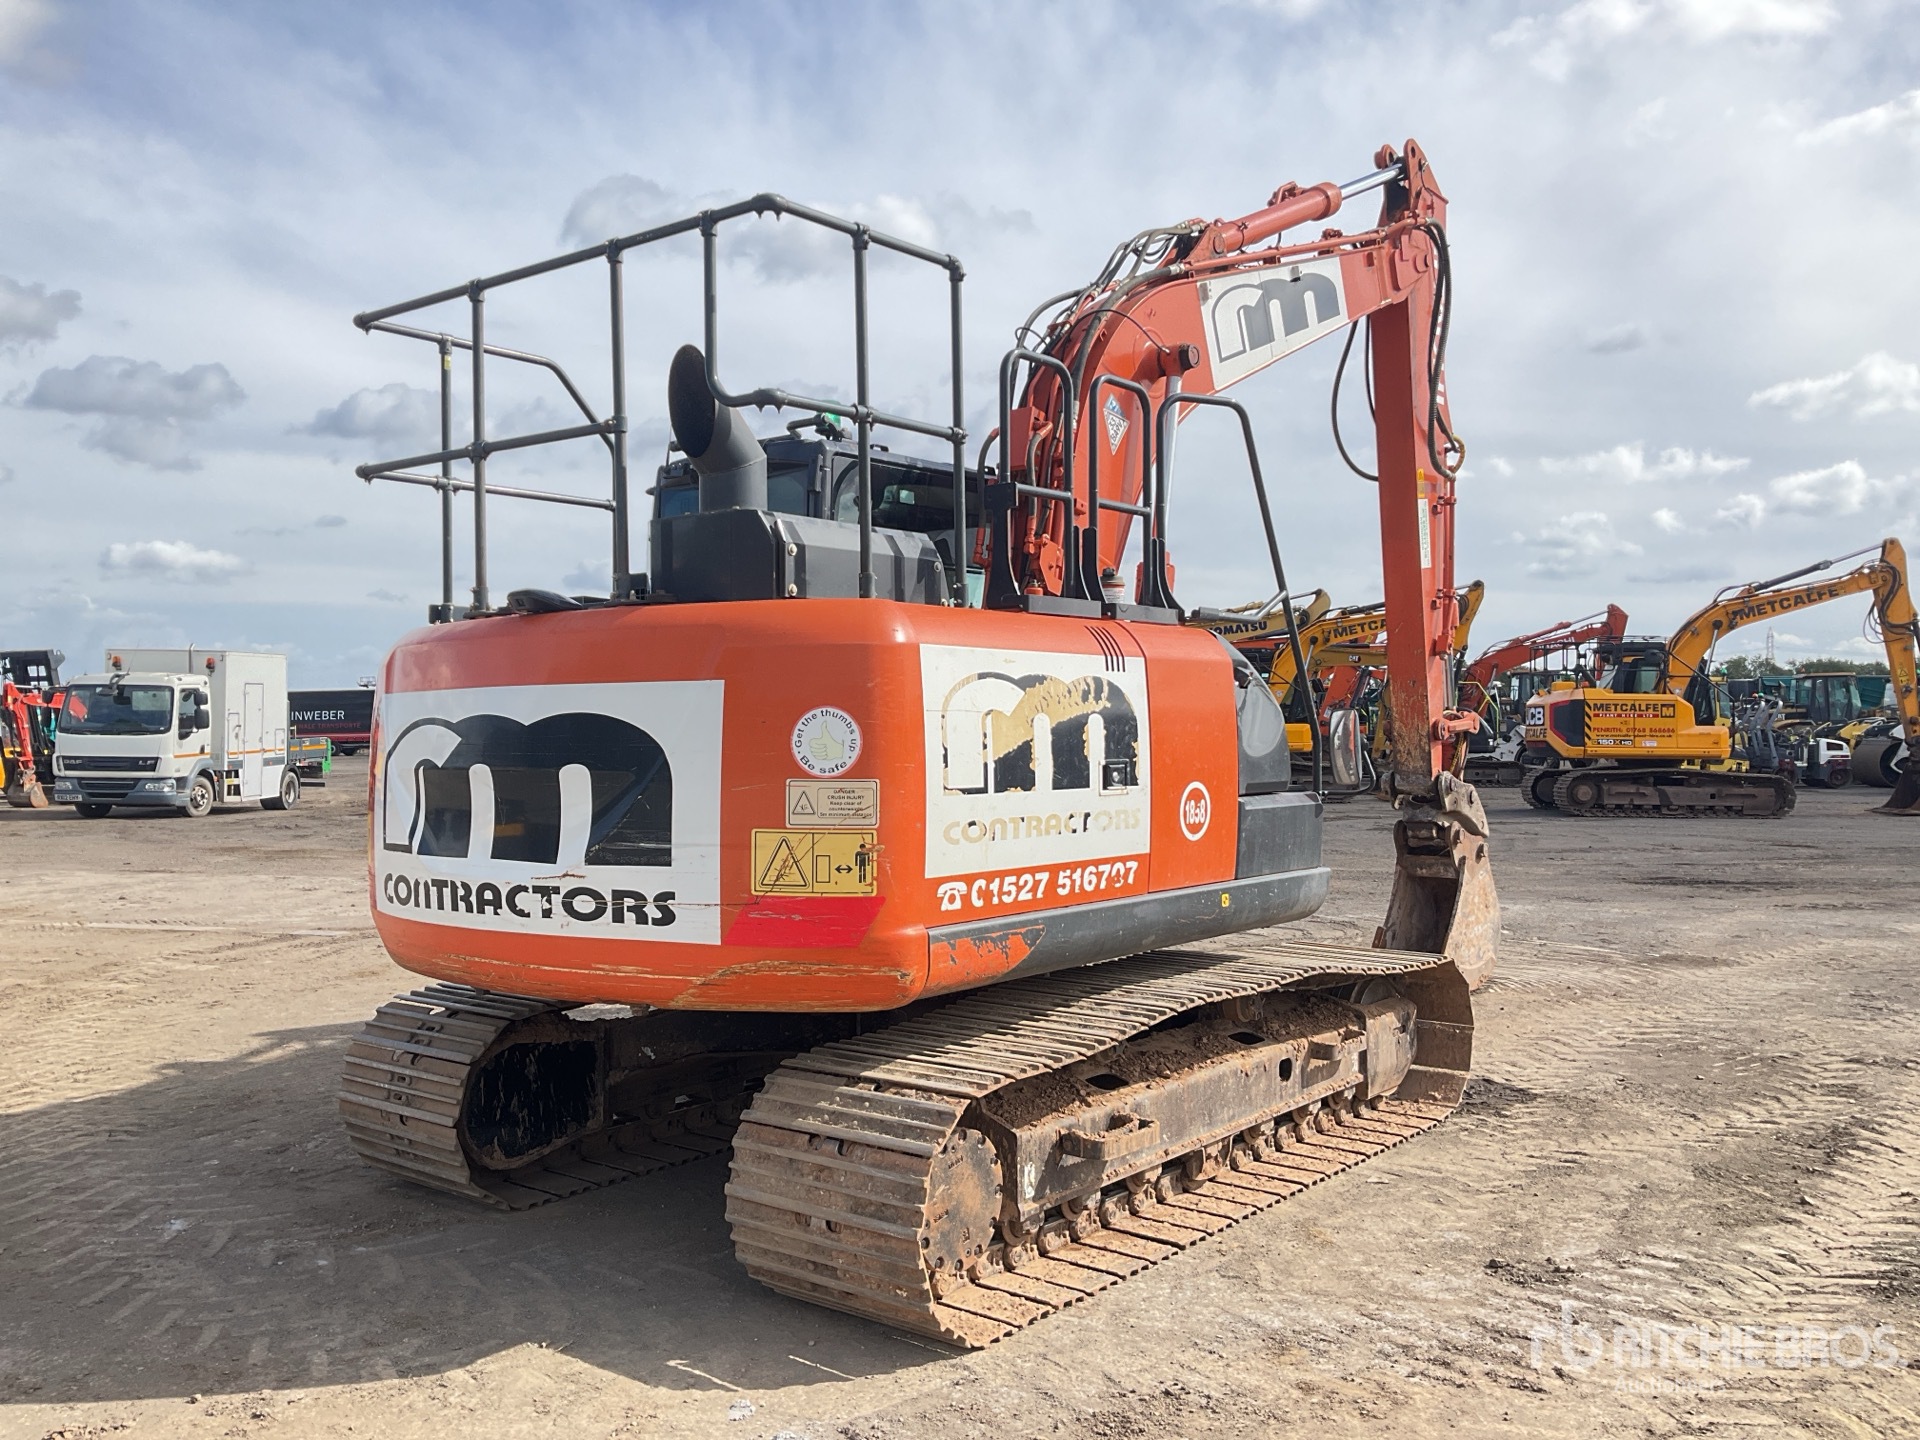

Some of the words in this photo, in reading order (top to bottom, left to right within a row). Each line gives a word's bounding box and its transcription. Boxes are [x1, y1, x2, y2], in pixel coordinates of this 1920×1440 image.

[1593, 703, 1660, 713] METCALFE
[794, 728, 804, 748] Get
[801, 713, 817, 727] the
[820, 709, 856, 735] thumbs
[848, 738, 857, 752] up
[800, 755, 815, 771] Be
[819, 761, 848, 774] safe
[384, 872, 677, 927] CONTRACTORS
